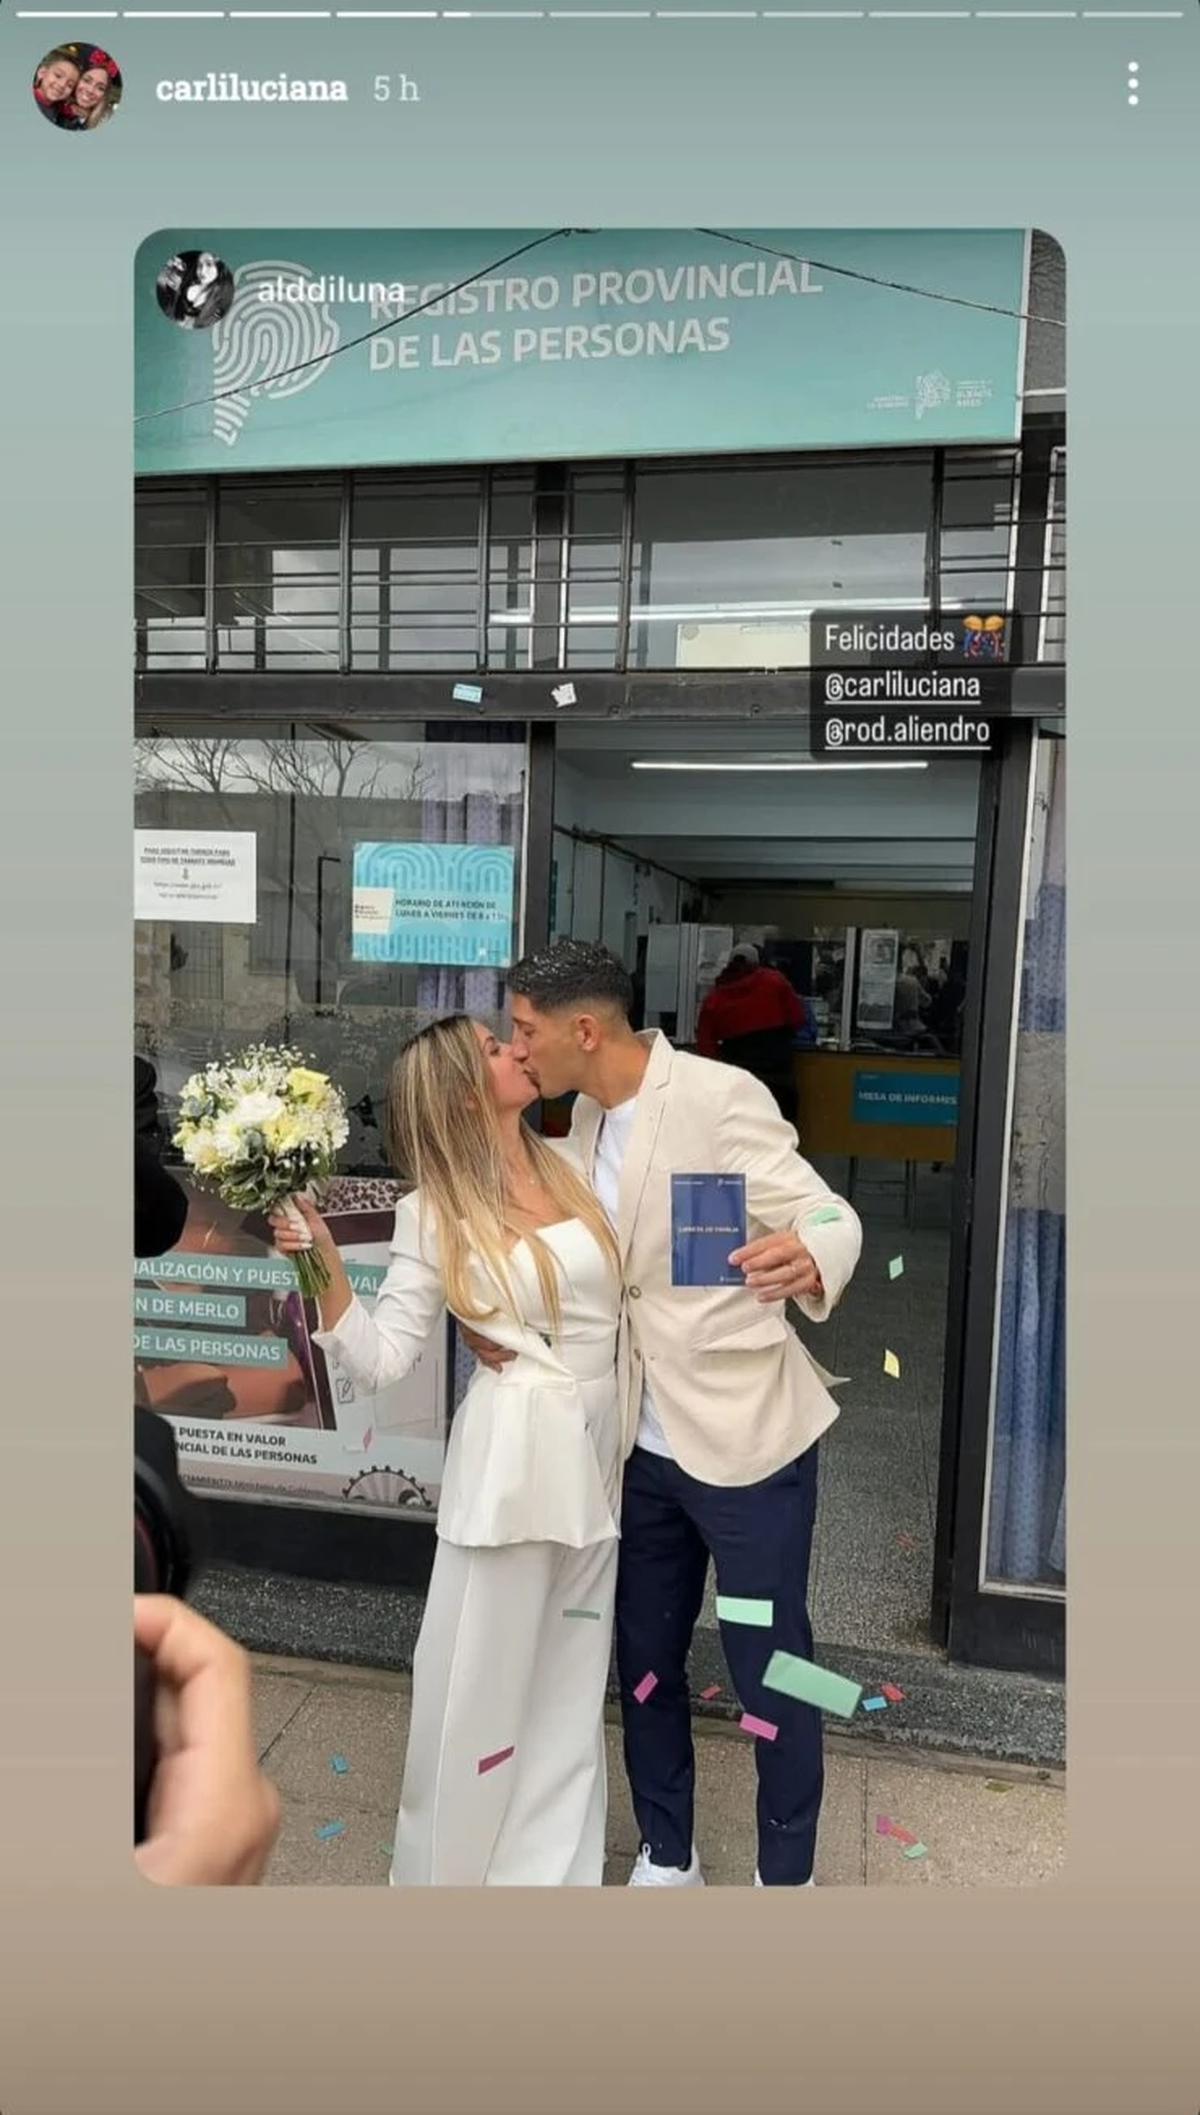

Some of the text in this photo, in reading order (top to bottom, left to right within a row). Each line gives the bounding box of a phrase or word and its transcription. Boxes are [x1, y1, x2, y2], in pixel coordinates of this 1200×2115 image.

[370, 260, 823, 320] REGISTRO PROVINCIAL
[370, 317, 730, 371] DE LAS PERSONAS
[232, 1268, 244, 1283] Y
[248, 1269, 301, 1287] PUEST
[349, 1275, 379, 1292] VAL
[152, 1299, 175, 1314] DE
[179, 1300, 239, 1319] MERLO
[155, 1336, 186, 1352] LAS
[190, 1339, 281, 1361] PERSONAS
[179, 1426, 286, 1447] PUESTA EN VALOR
[211, 1445, 228, 1457] DE
[230, 1447, 252, 1459] LAS
[254, 1449, 318, 1465] PERSONAS
